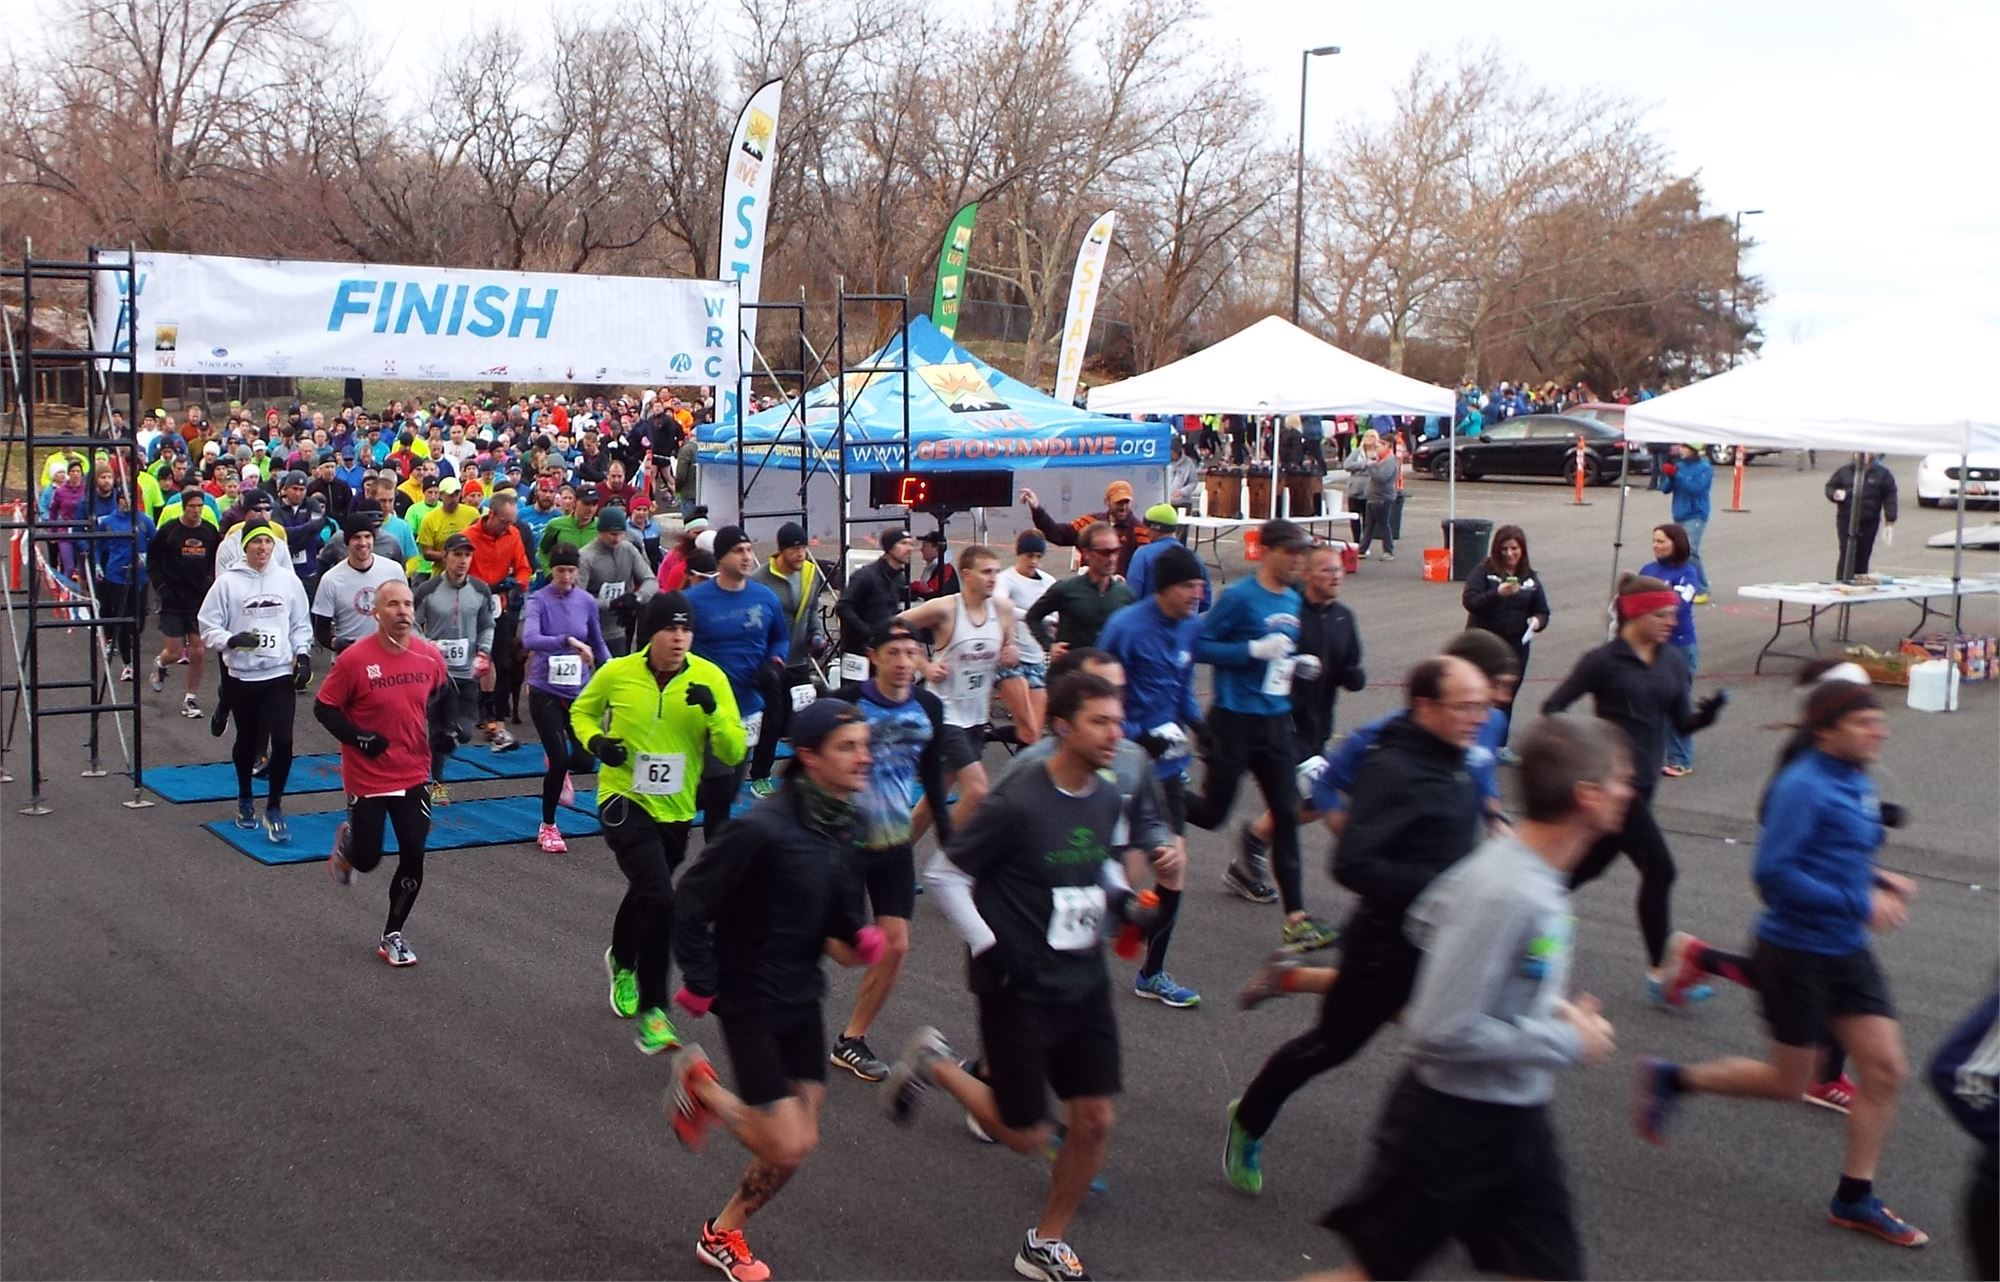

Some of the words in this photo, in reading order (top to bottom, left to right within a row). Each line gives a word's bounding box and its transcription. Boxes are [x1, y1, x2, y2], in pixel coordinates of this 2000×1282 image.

[327, 280, 558, 338] FINISH
[556, 663, 577, 676] 120
[648, 763, 671, 783] 62
